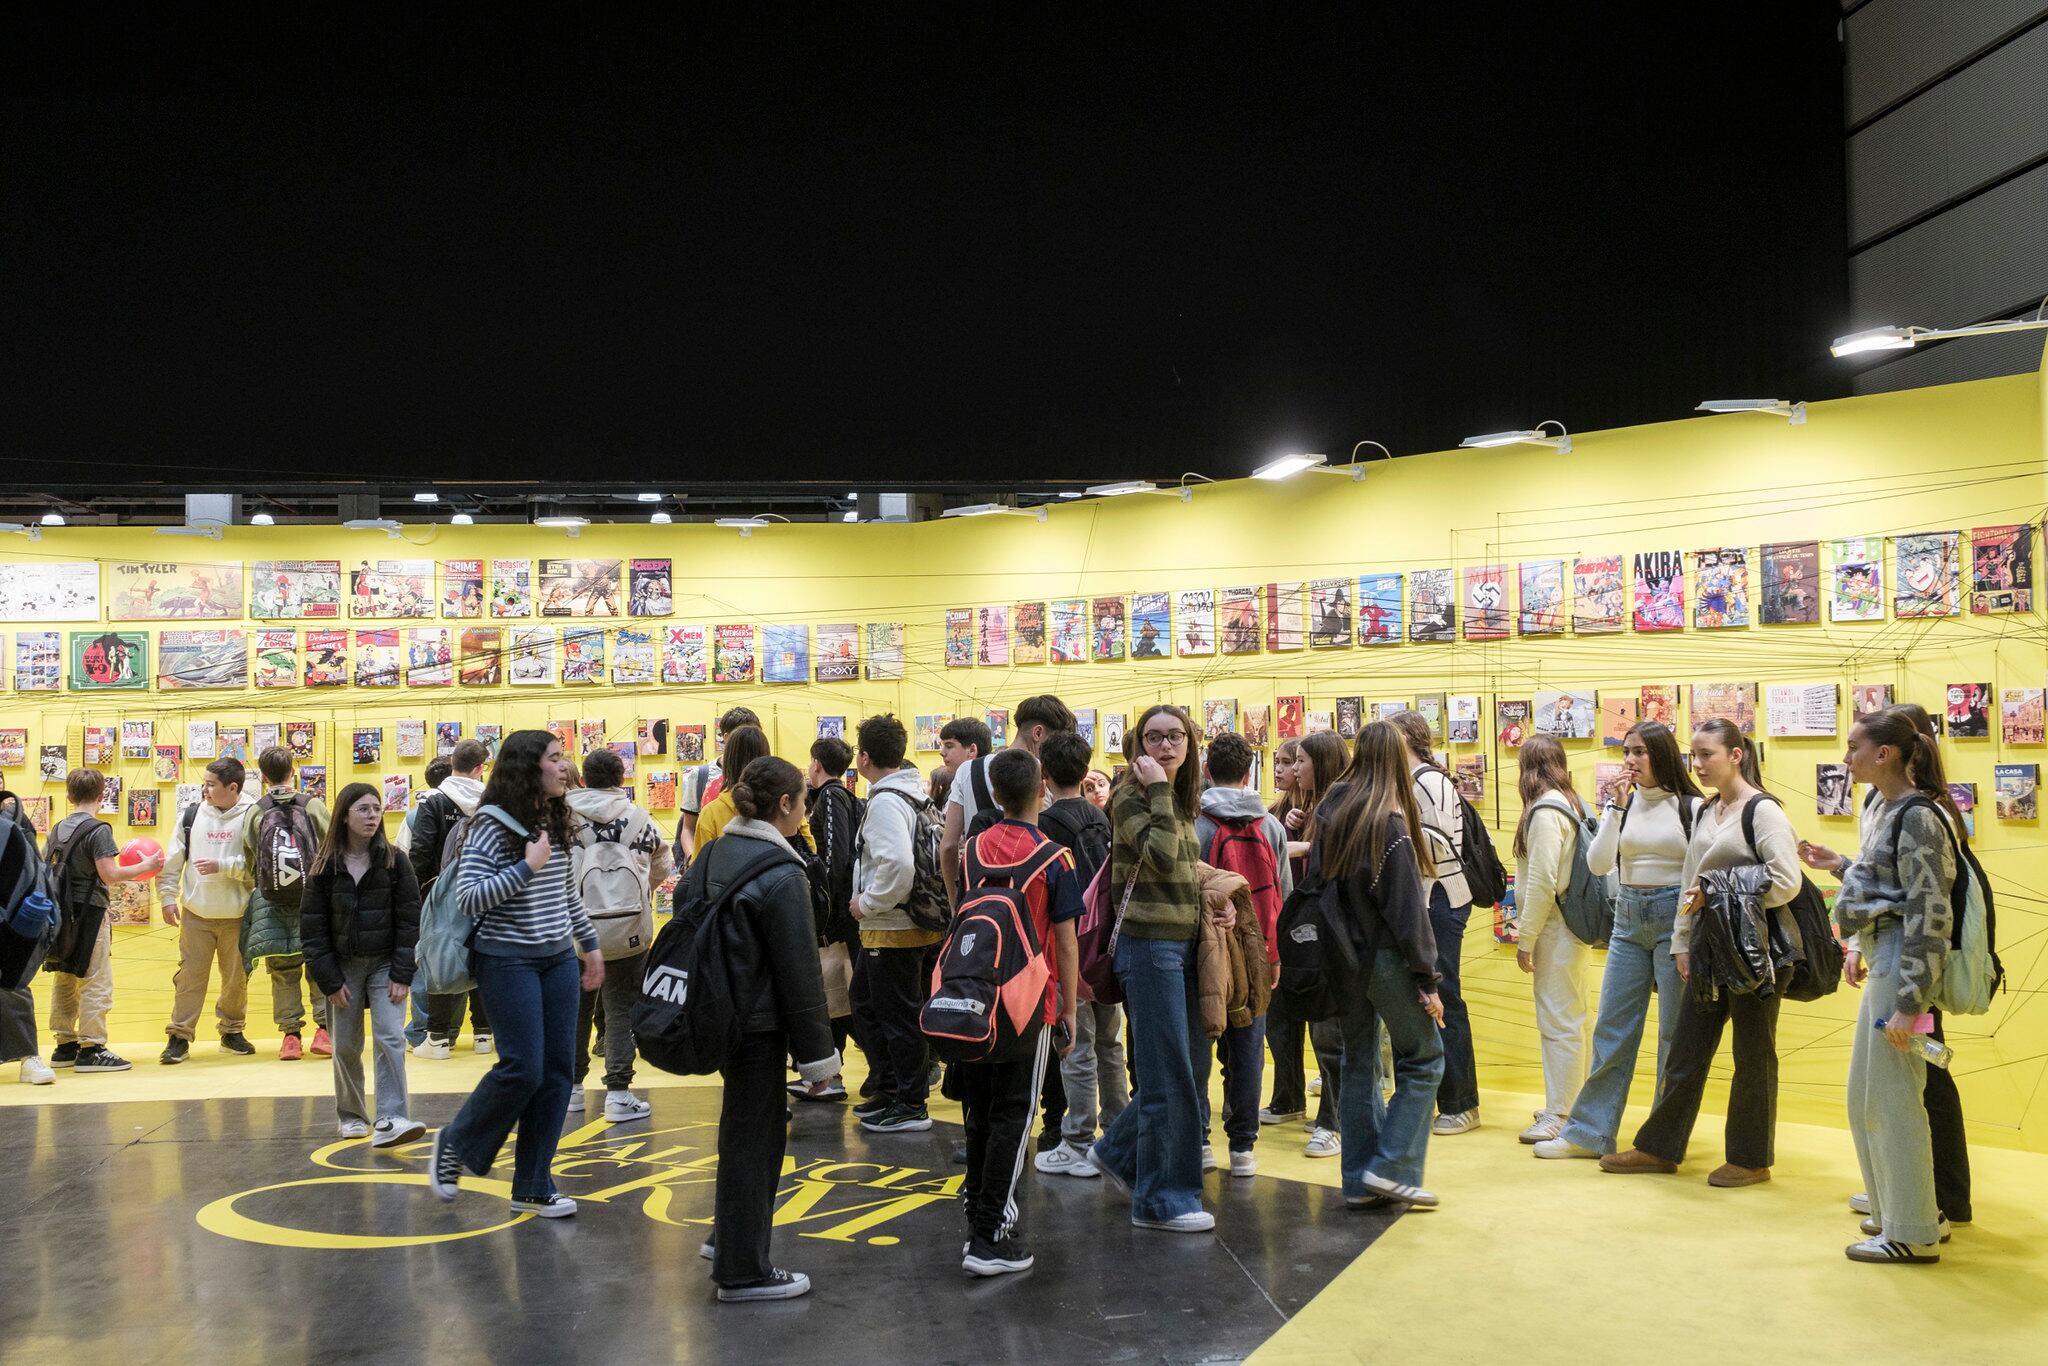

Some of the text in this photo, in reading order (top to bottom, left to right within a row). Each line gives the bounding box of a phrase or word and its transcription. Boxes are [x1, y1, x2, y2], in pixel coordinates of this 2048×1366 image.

[117, 563, 177, 575] TIM TYLER
[450, 561, 477, 572] CRIME
[494, 560, 526, 570] Fantastic
[634, 560, 671, 571] CREEPY
[1634, 551, 1683, 579] AKIRA
[1469, 569, 1503, 585] MAUS
[670, 628, 703, 645] X-MEN
[278, 828, 302, 887] FILA
